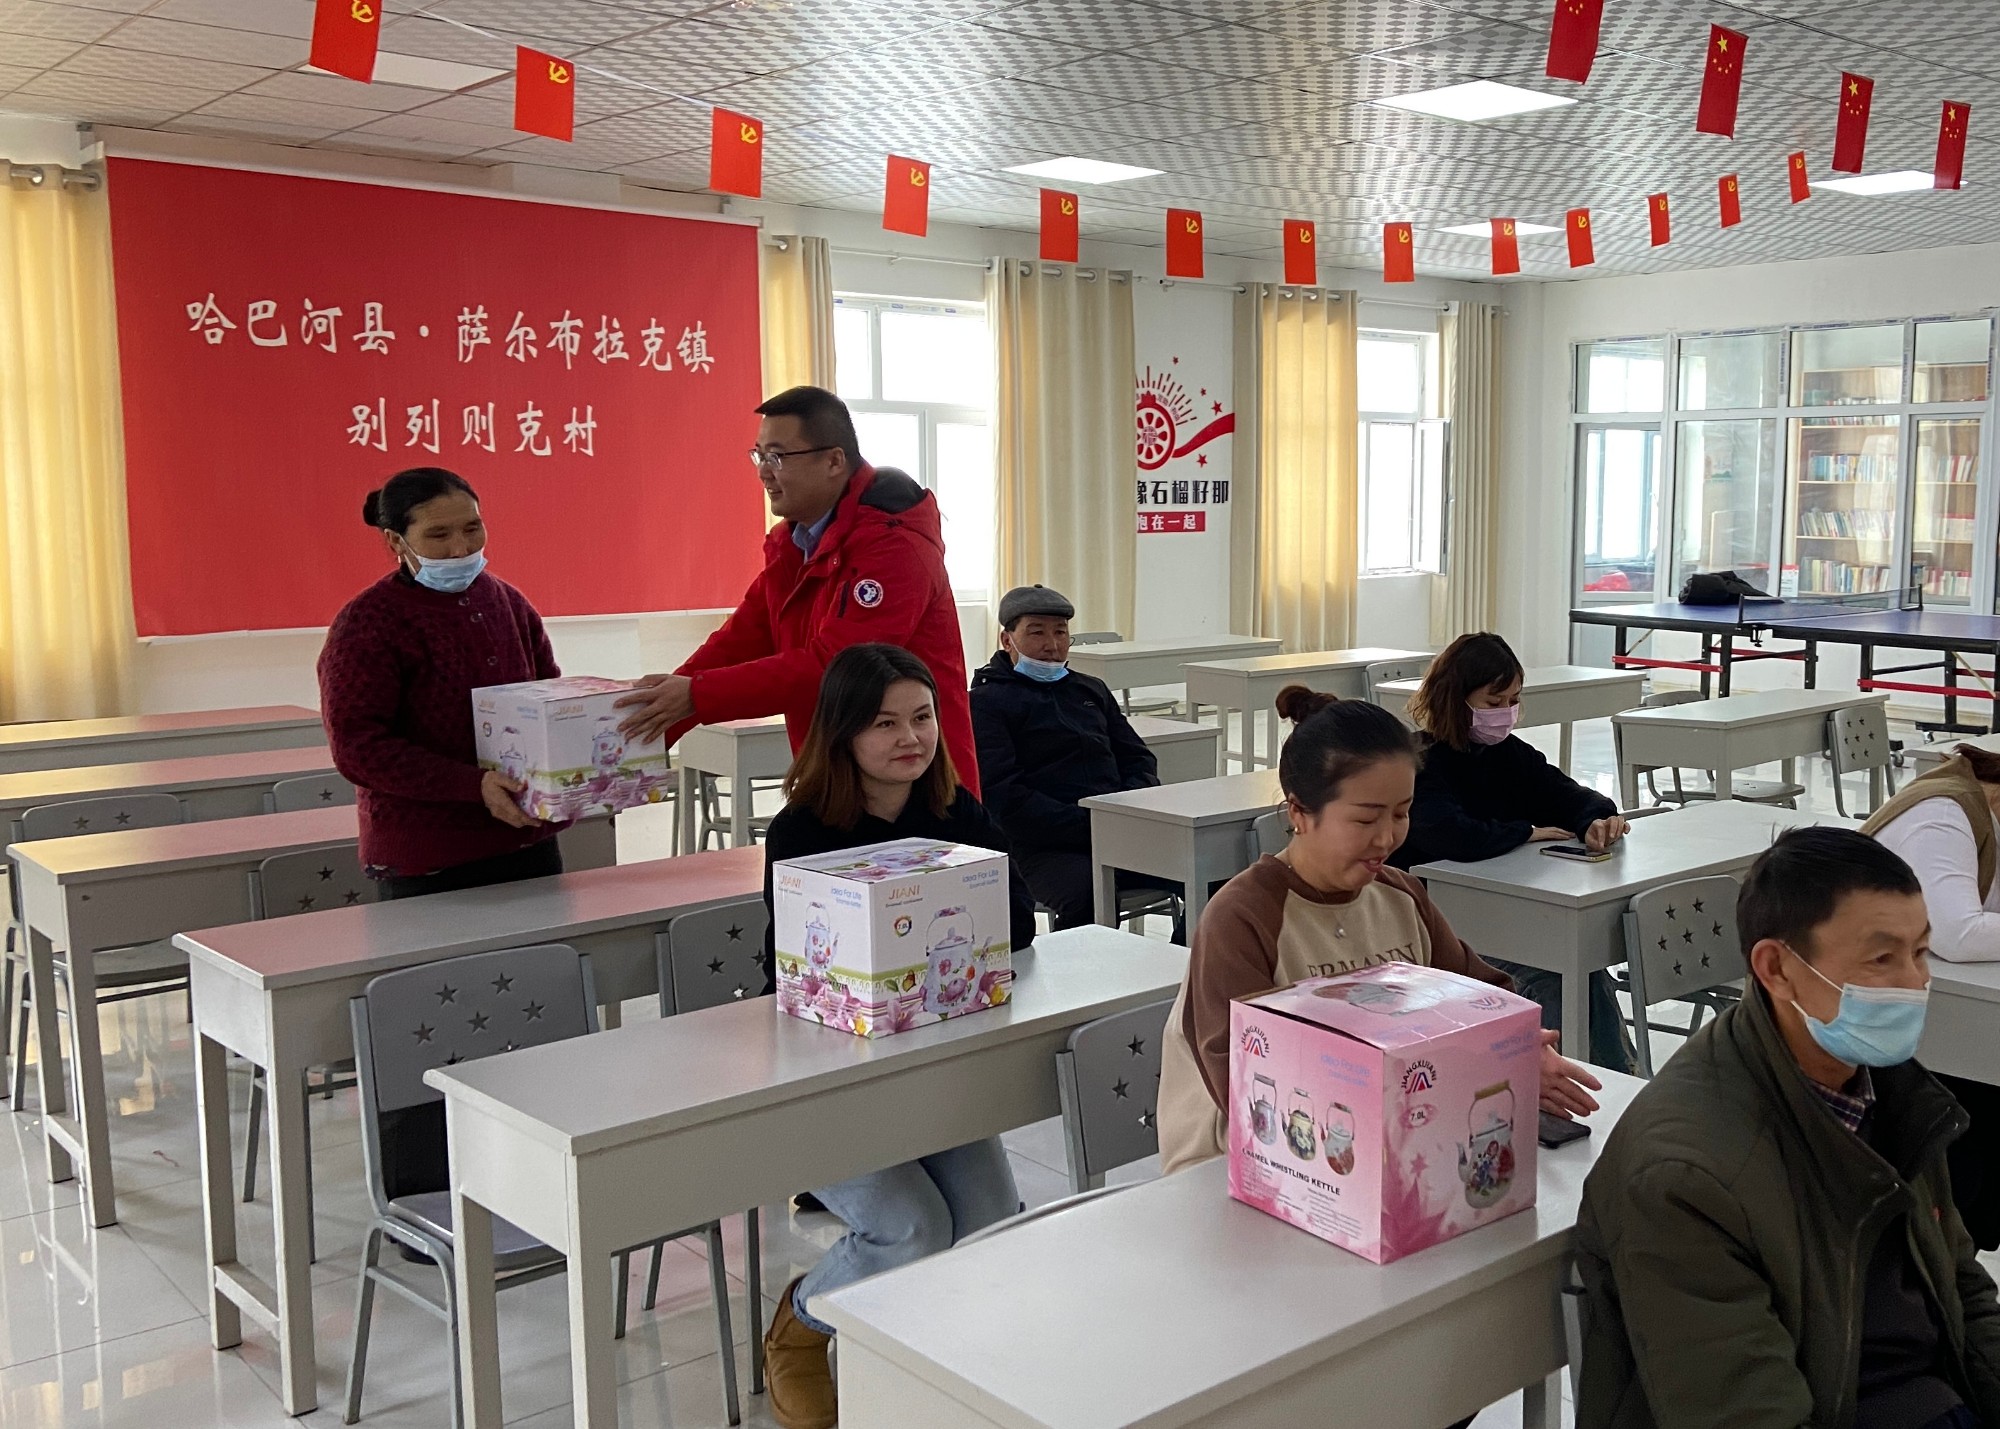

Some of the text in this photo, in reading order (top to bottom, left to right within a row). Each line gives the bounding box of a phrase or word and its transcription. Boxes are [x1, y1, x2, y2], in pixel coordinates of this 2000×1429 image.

[186, 293, 715, 374] 哈巴河县·萨尔布拉克镇
[346, 397, 598, 457] 别列则克村
[780, 875, 802, 888] JIANI
[889, 885, 921, 900] JIANI
[1410, 1109, 1426, 1121] 7.0L
[1270, 1160, 1310, 1183] WHISTLING
[1311, 1177, 1341, 1195] KETTLE
